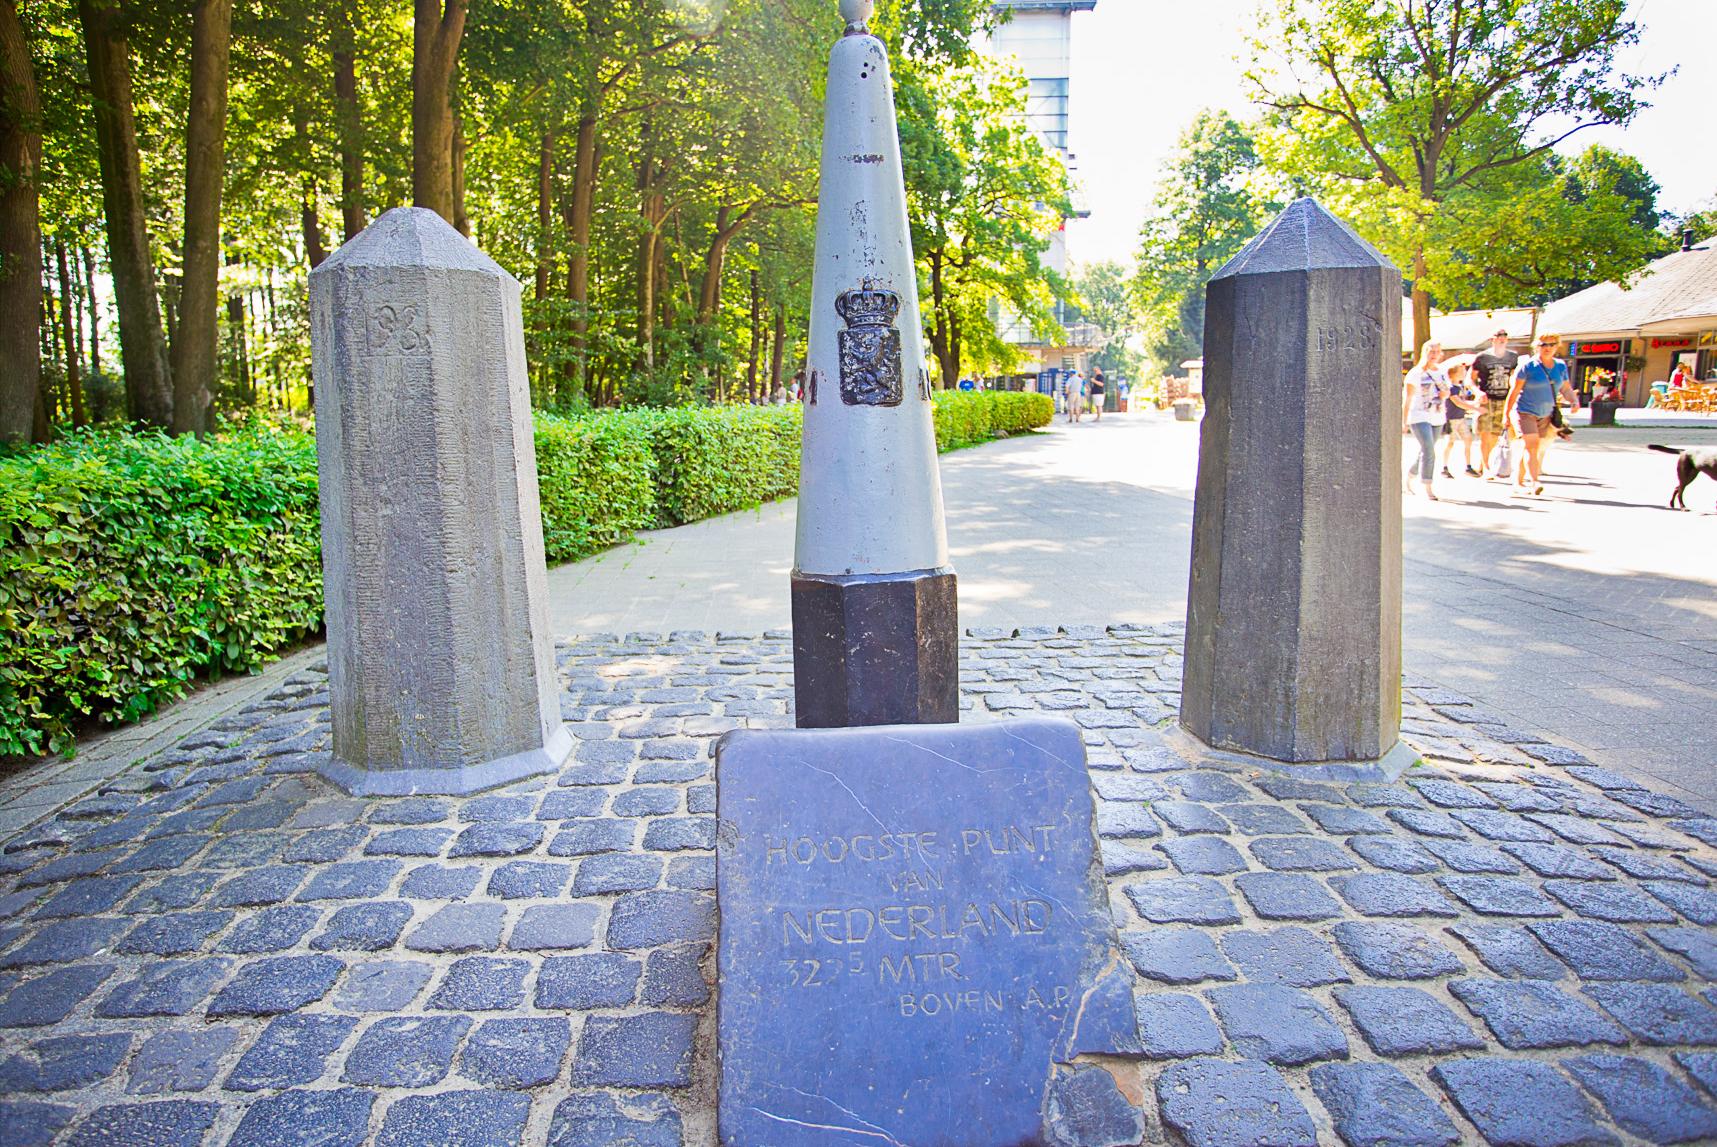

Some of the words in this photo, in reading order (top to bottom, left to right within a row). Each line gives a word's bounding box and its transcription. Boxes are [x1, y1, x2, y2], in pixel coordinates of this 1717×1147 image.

[766, 830, 938, 865] HOOGSTE
[961, 825, 1056, 855] PUNT
[887, 869, 945, 893] VAN
[782, 900, 1053, 946] NEDERLAND
[900, 990, 1003, 1017] BOVEN
